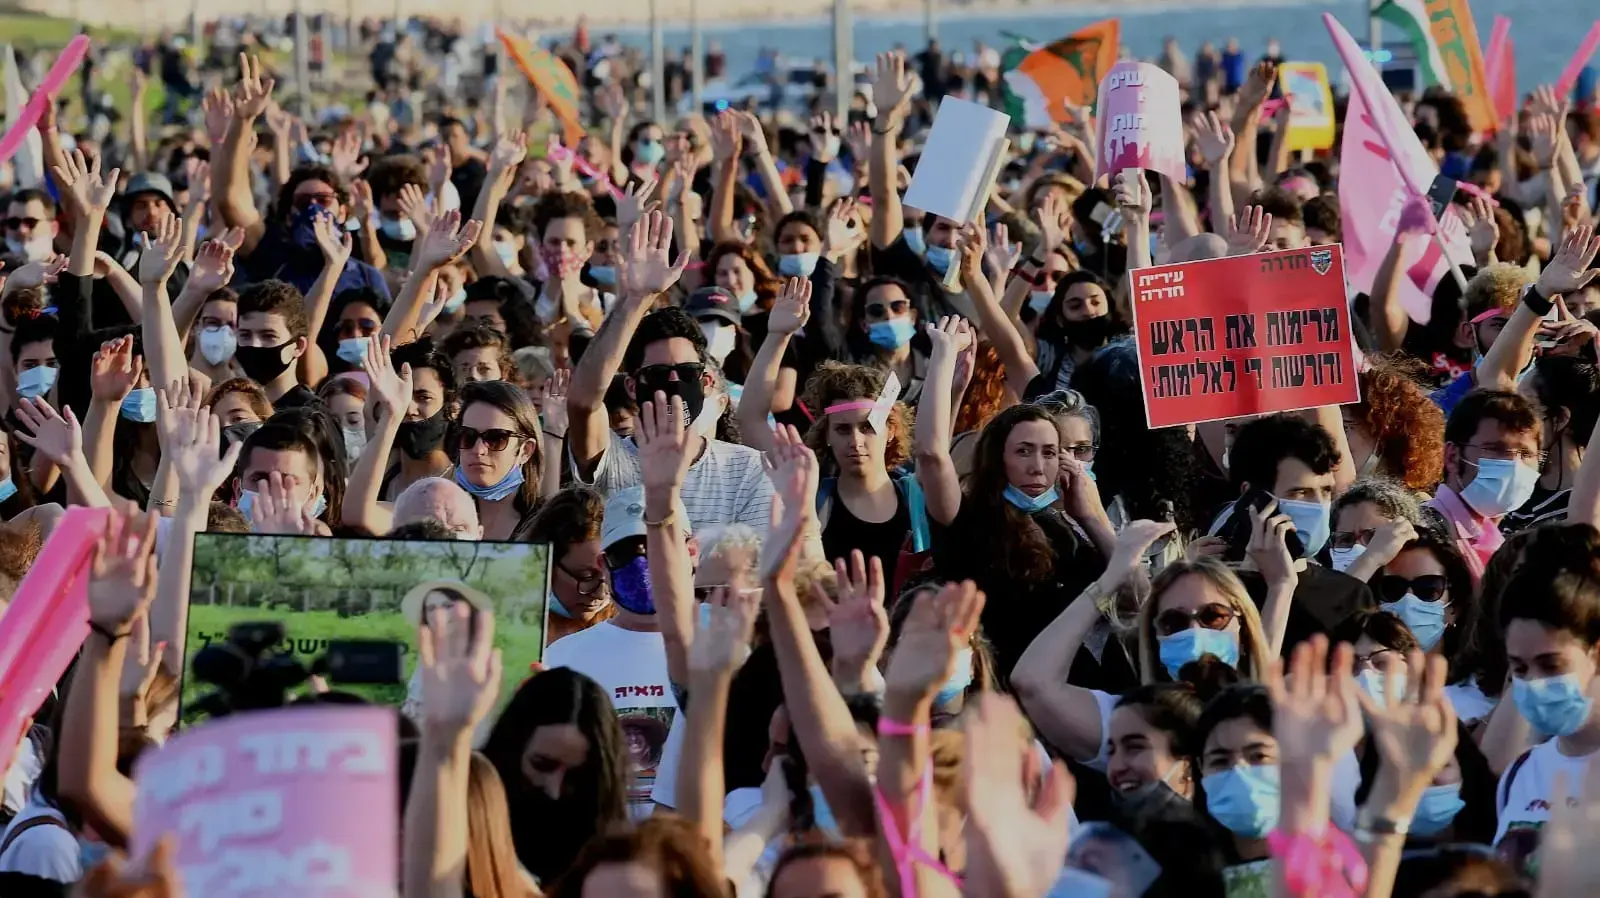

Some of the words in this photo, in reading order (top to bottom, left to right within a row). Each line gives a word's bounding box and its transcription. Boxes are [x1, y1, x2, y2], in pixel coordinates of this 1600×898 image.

[1138, 270, 1185, 288] עיריית
[1260, 253, 1309, 273] חדרה
[1140, 285, 1185, 302] חדרה
[1149, 316, 1216, 356] הראש
[1224, 313, 1258, 350] את
[1266, 307, 1340, 347] מרימות
[1150, 355, 1238, 398] לאלימות!
[1244, 357, 1264, 391] די
[1271, 351, 1343, 389] ודורשות
[615, 685, 664, 698] מאיה
